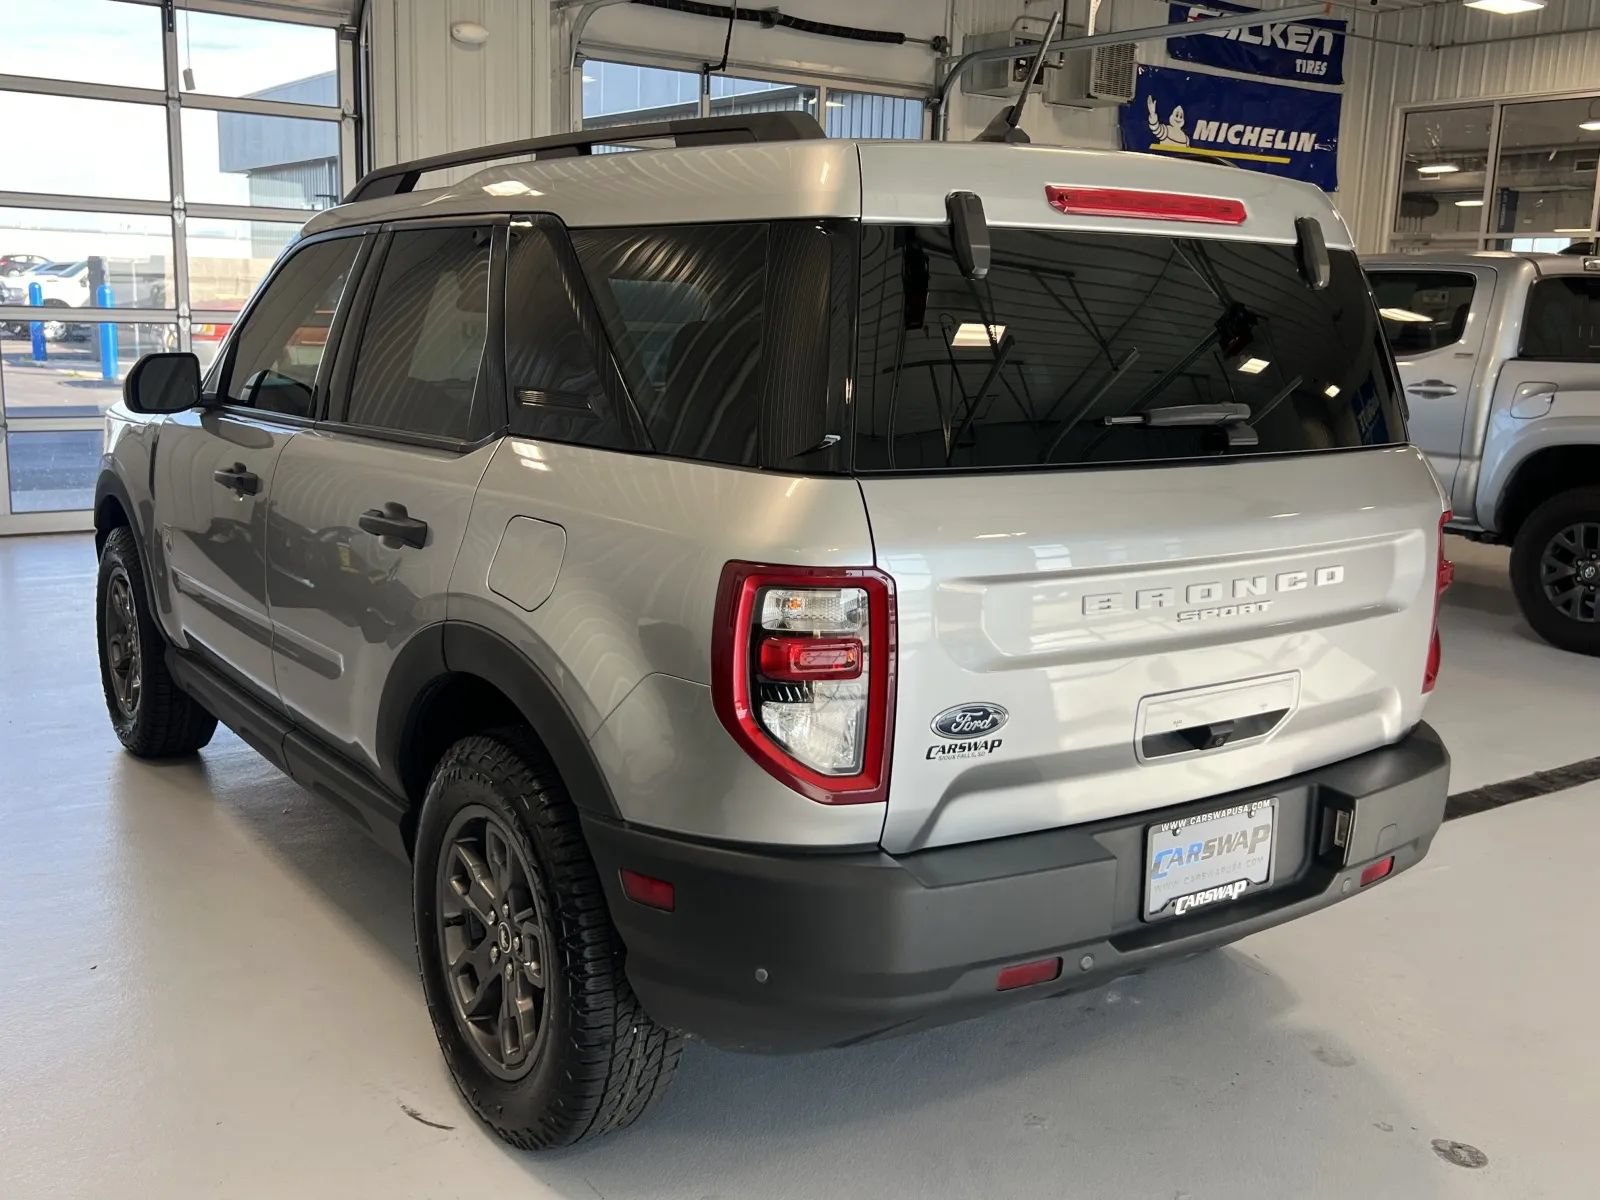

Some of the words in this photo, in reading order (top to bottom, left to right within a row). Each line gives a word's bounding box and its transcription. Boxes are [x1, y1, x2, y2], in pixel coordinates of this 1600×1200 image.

[1296, 59, 1328, 76] TIRES
[1193, 119, 1317, 153] MICHELIN
[1082, 565, 1345, 616] BRONCO
[1177, 600, 1273, 622] SPORT
[951, 711, 993, 732] Ford
[925, 738, 1003, 760] CARSWAP
[1161, 799, 1271, 832] WWW.CARSWAPUSA.COM
[1151, 824, 1271, 880] CARSWAP
[1175, 879, 1248, 915] CARSWAP
